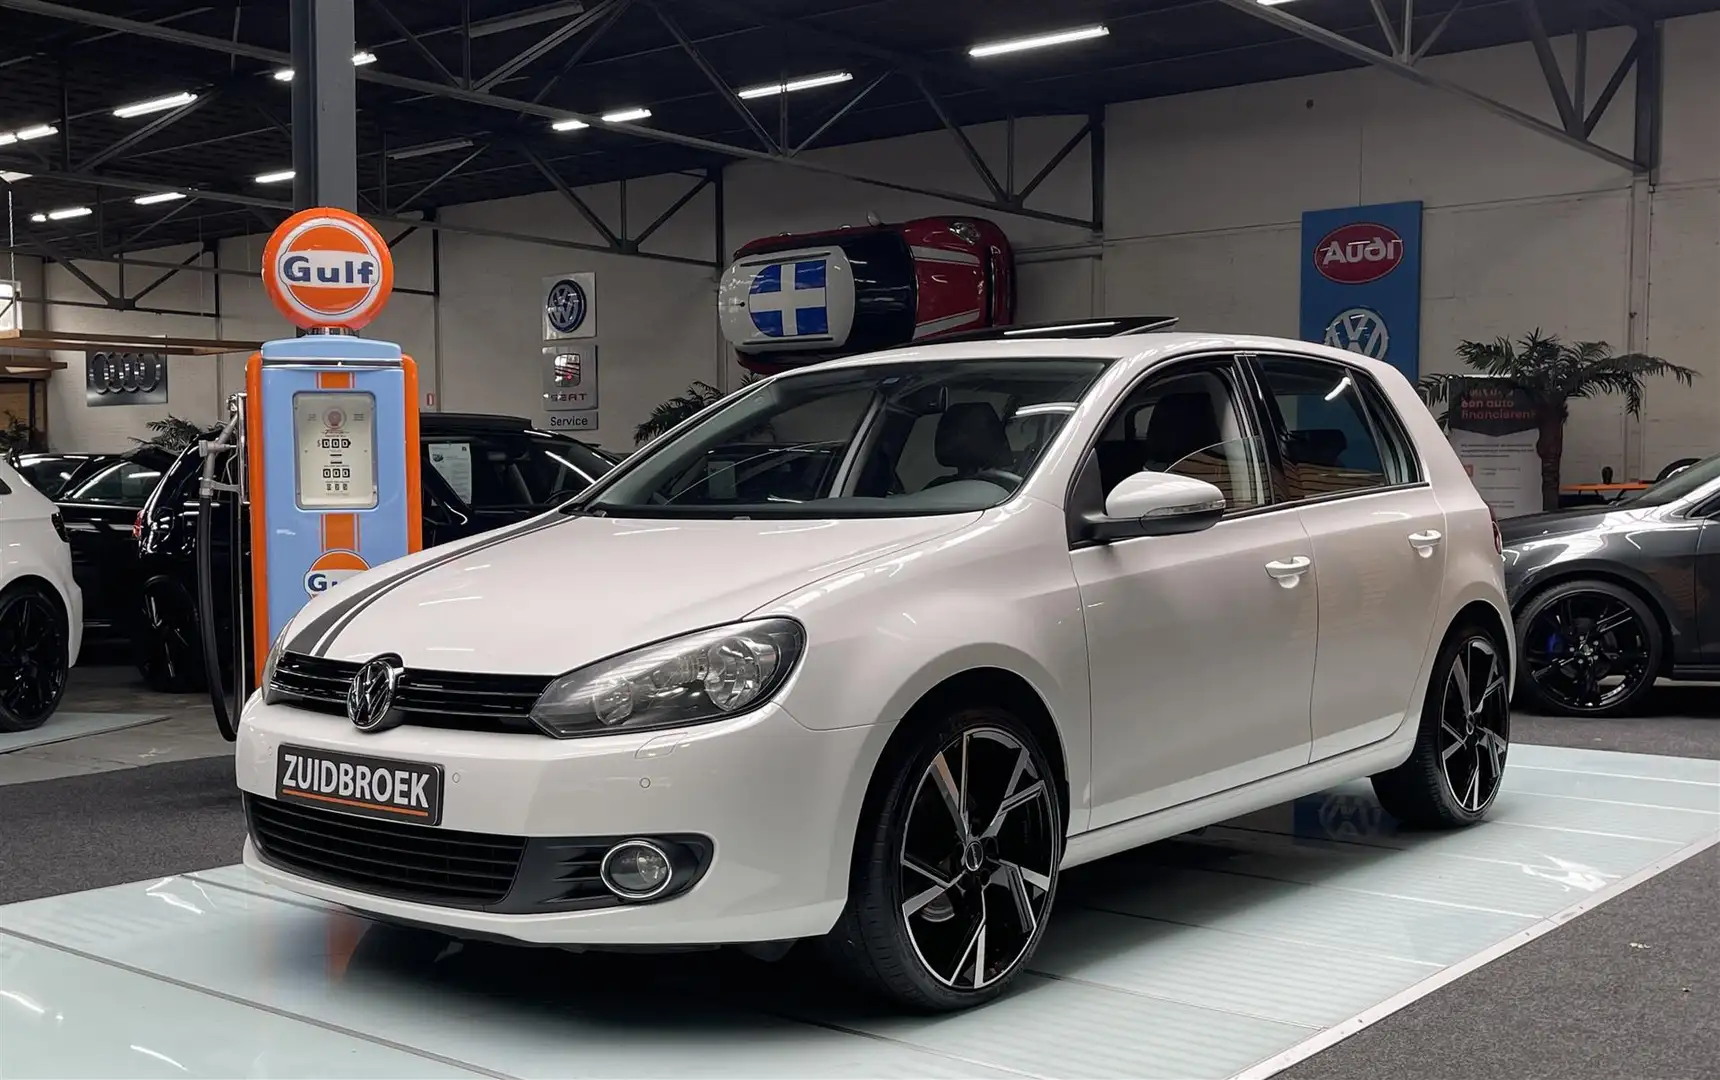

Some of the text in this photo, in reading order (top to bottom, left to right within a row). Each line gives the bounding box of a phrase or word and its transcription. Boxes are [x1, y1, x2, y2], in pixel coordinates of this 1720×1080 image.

[1322, 237, 1395, 265] Audi
[283, 255, 374, 284] Gulf
[551, 393, 588, 402] SEAT
[1486, 399, 1515, 408] auto
[550, 416, 588, 427] Service
[282, 754, 430, 809] ZUIDBROEK
